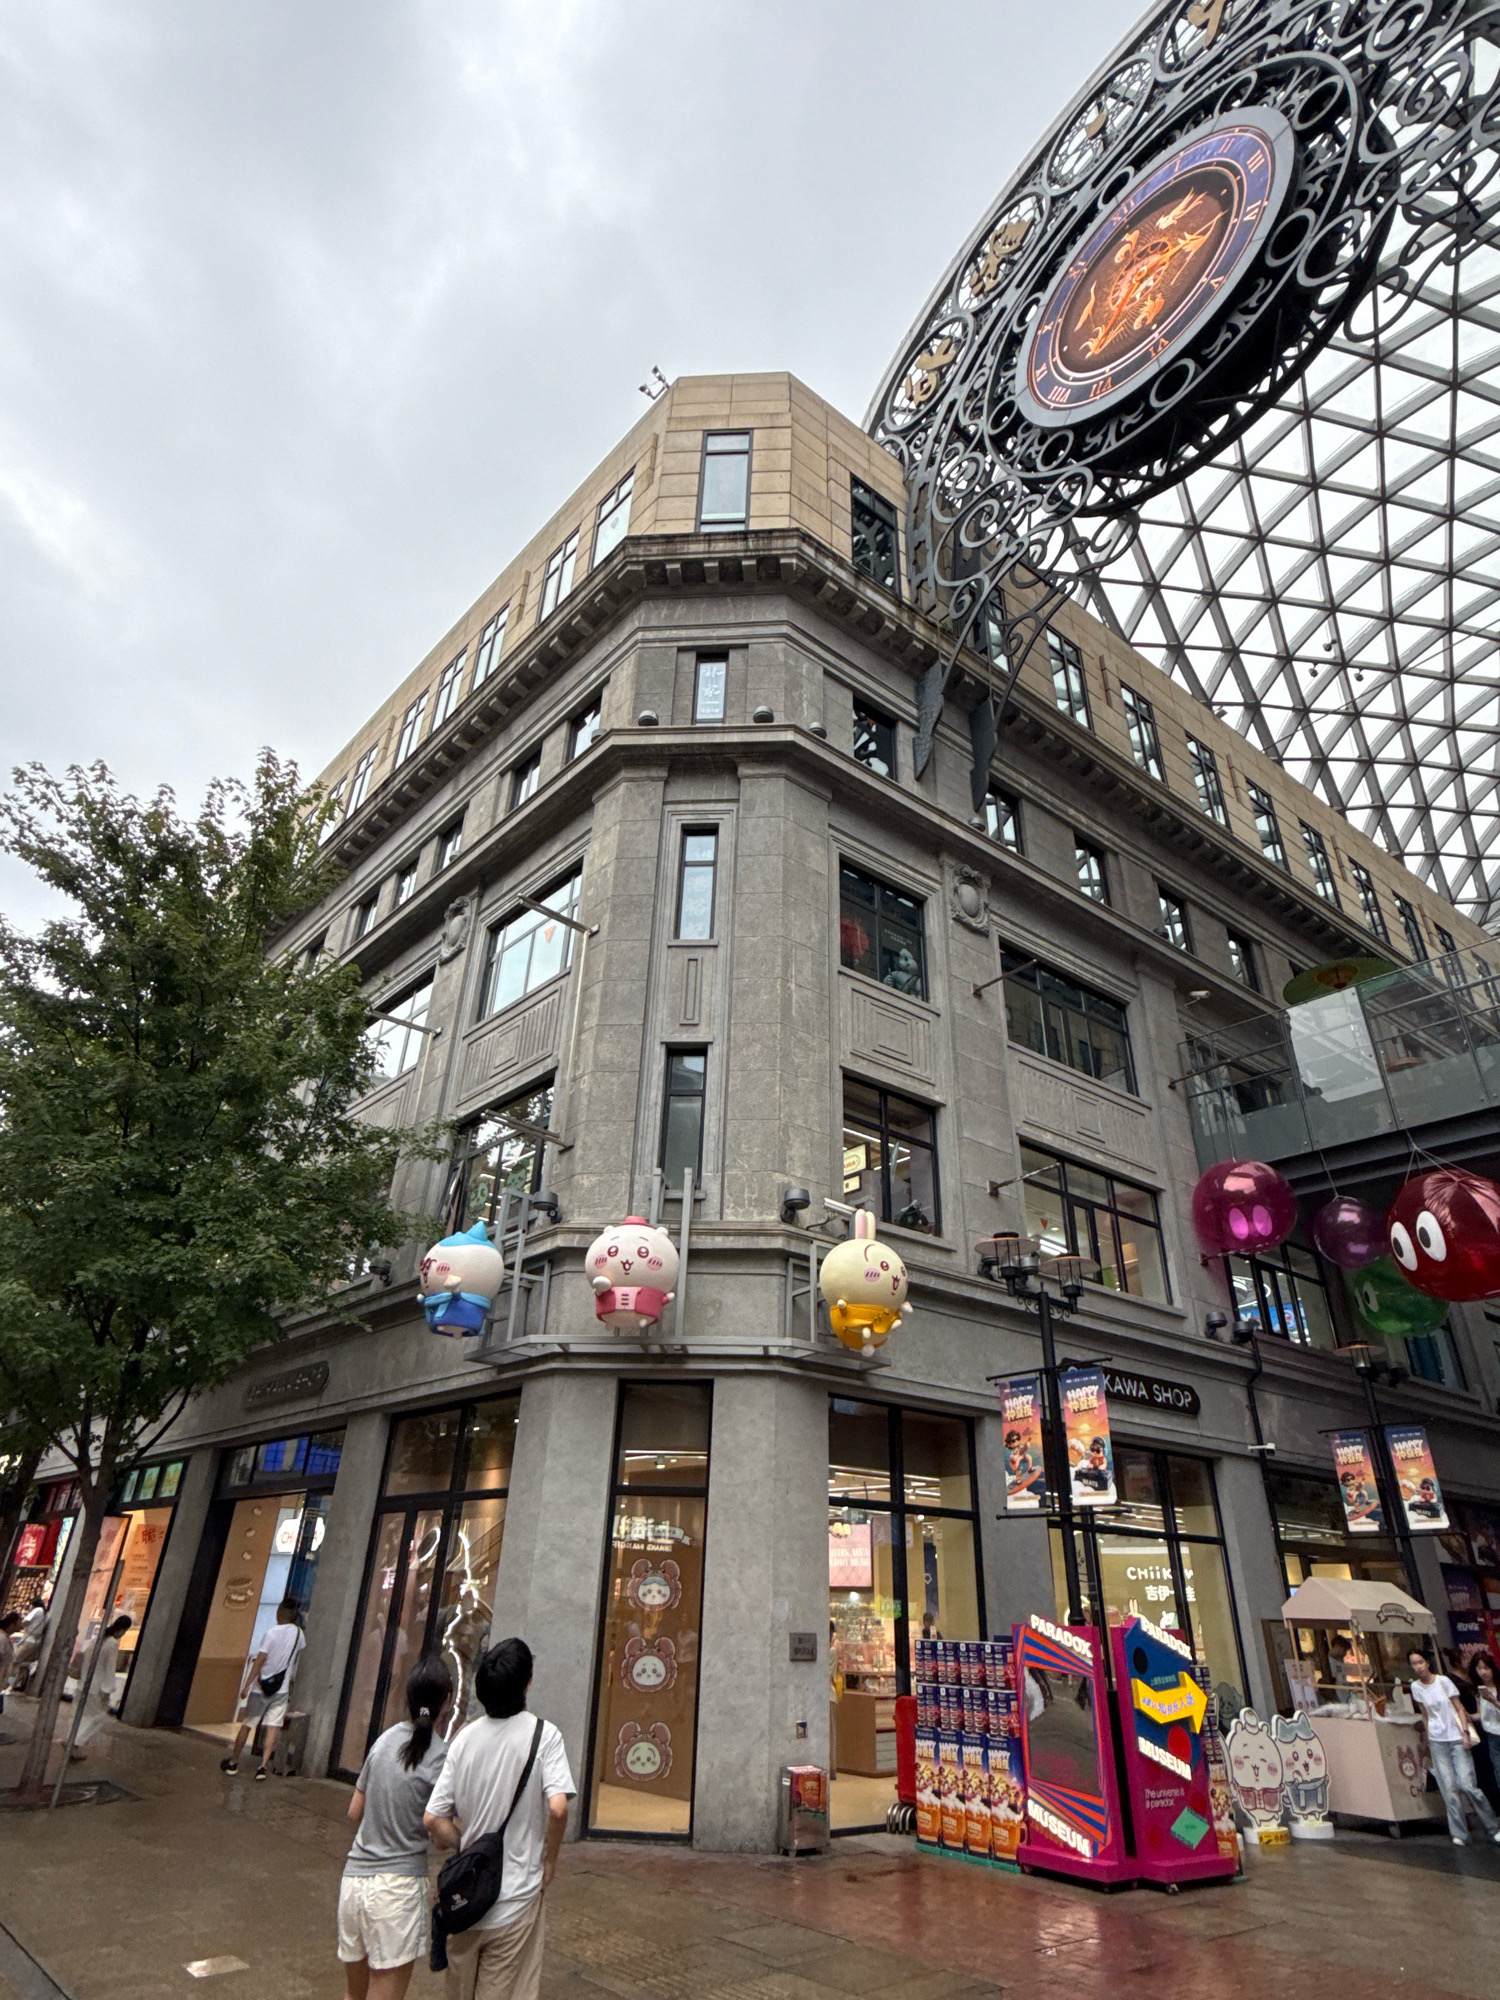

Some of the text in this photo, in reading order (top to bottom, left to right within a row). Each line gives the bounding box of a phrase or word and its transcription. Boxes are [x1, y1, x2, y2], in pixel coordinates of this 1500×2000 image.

[1004, 1394, 1034, 1411] HAPPY
[1066, 1385, 1099, 1401] HAPPY
[1103, 1373, 1192, 1408] KAWA SHOP
[1030, 1613, 1093, 1658] PARADOX
[1140, 1616, 1193, 1661] PARADOX
[1137, 1735, 1192, 1781] MUSEUM
[1145, 1786, 1185, 1798] The universe is
[1150, 1798, 1175, 1810] paradox
[1027, 1798, 1091, 1858] MUSEUM
